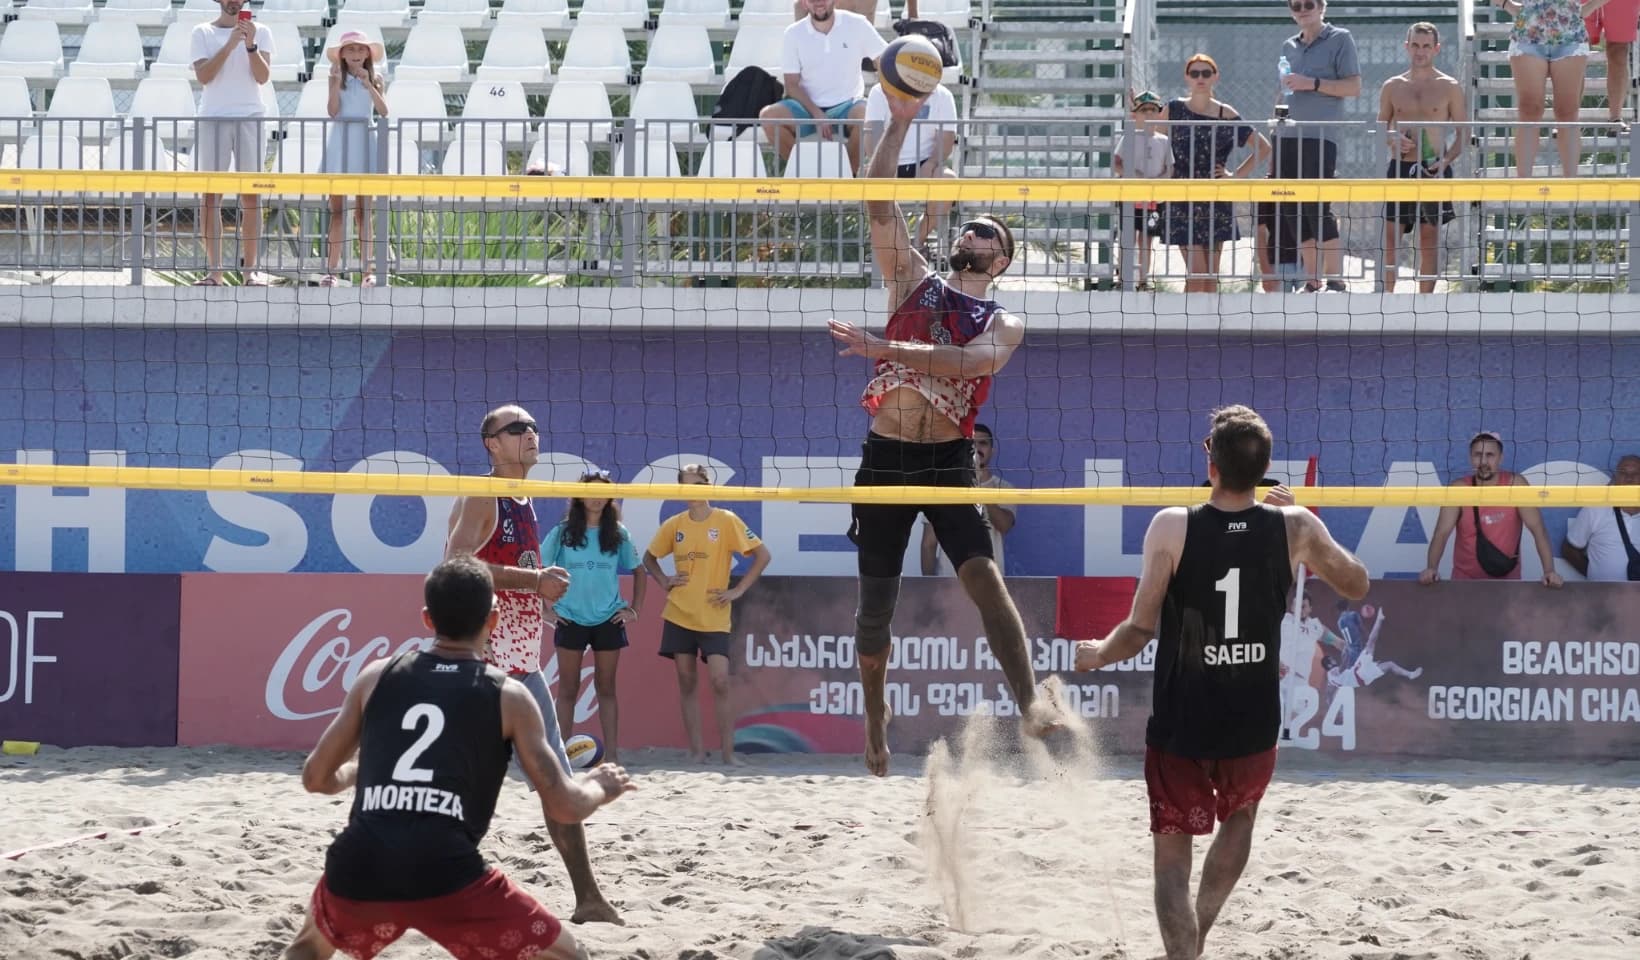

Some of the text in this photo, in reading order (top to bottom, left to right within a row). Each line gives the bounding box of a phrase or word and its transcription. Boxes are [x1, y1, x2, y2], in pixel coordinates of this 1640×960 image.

[489, 86, 505, 97] 46
[1215, 567, 1241, 639] 1
[745, 633, 968, 670] საქართელოს
[1203, 642, 1266, 666] SAEID
[1502, 640, 1640, 676] BEACHSO
[809, 680, 920, 716] ქვიის
[1428, 685, 1640, 722] GEORGIAN CHA
[391, 702, 446, 782] 2
[361, 783, 465, 821] MORTEZA
